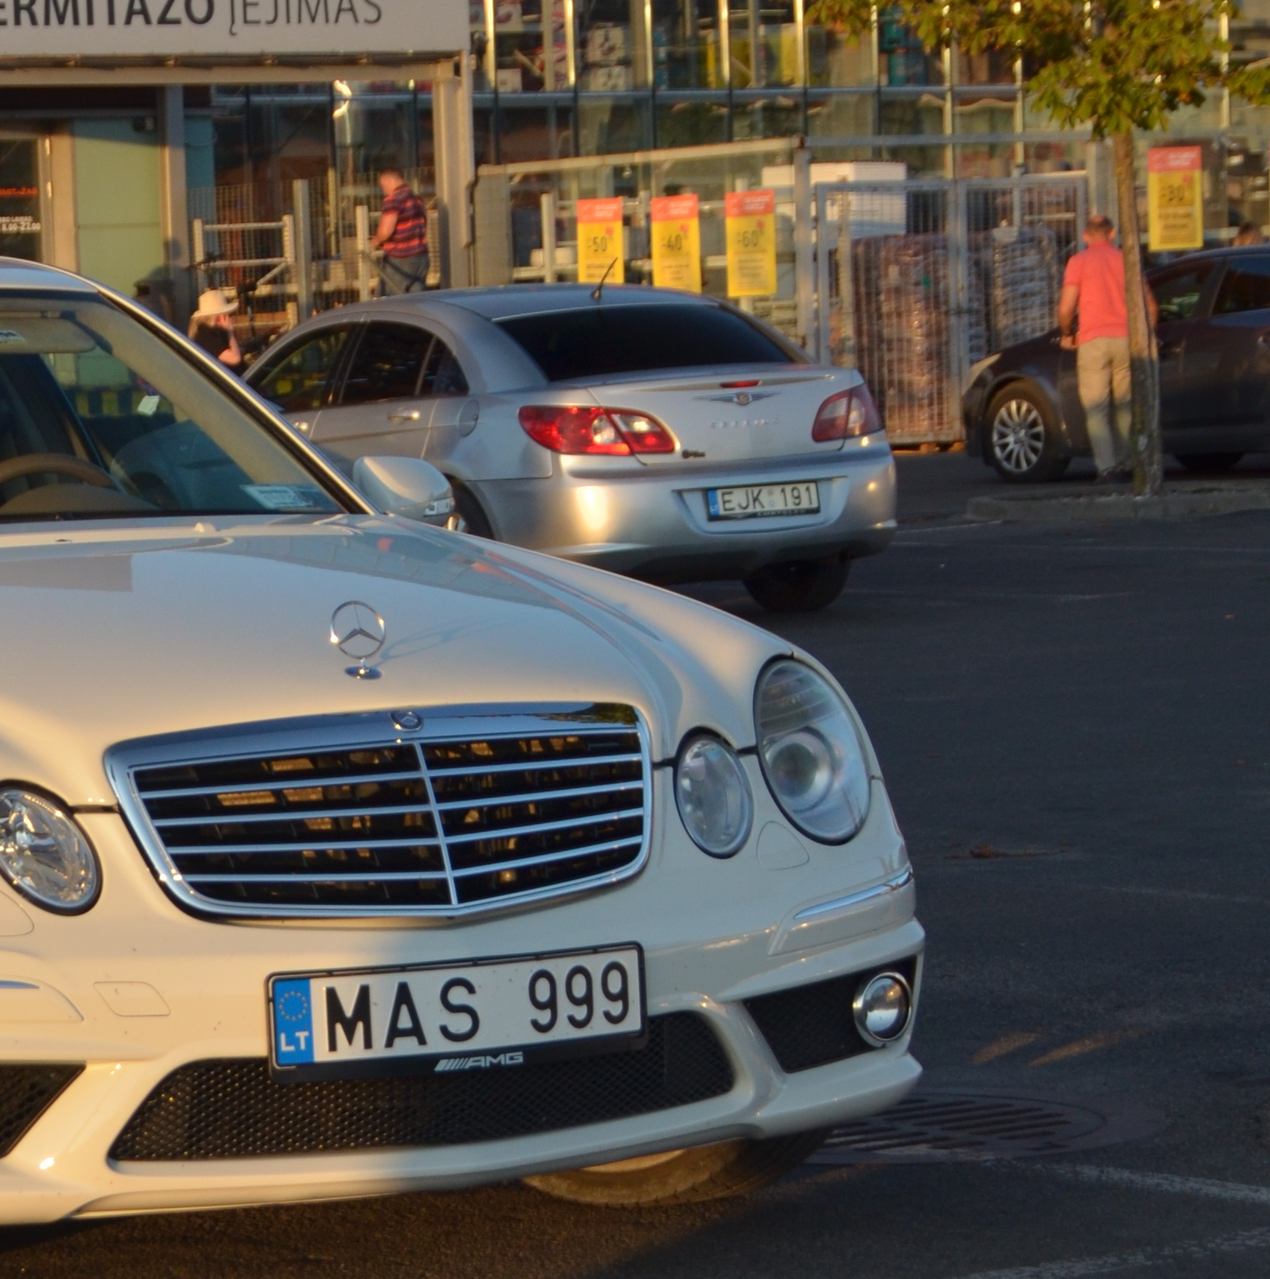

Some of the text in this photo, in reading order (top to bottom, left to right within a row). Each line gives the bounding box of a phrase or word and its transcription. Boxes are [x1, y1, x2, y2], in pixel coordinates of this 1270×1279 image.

[721, 484, 813, 512] EJK 191
[324, 960, 630, 1053] MAS 999
[279, 1031, 309, 1052] LT
[465, 1051, 524, 1069] AMG
